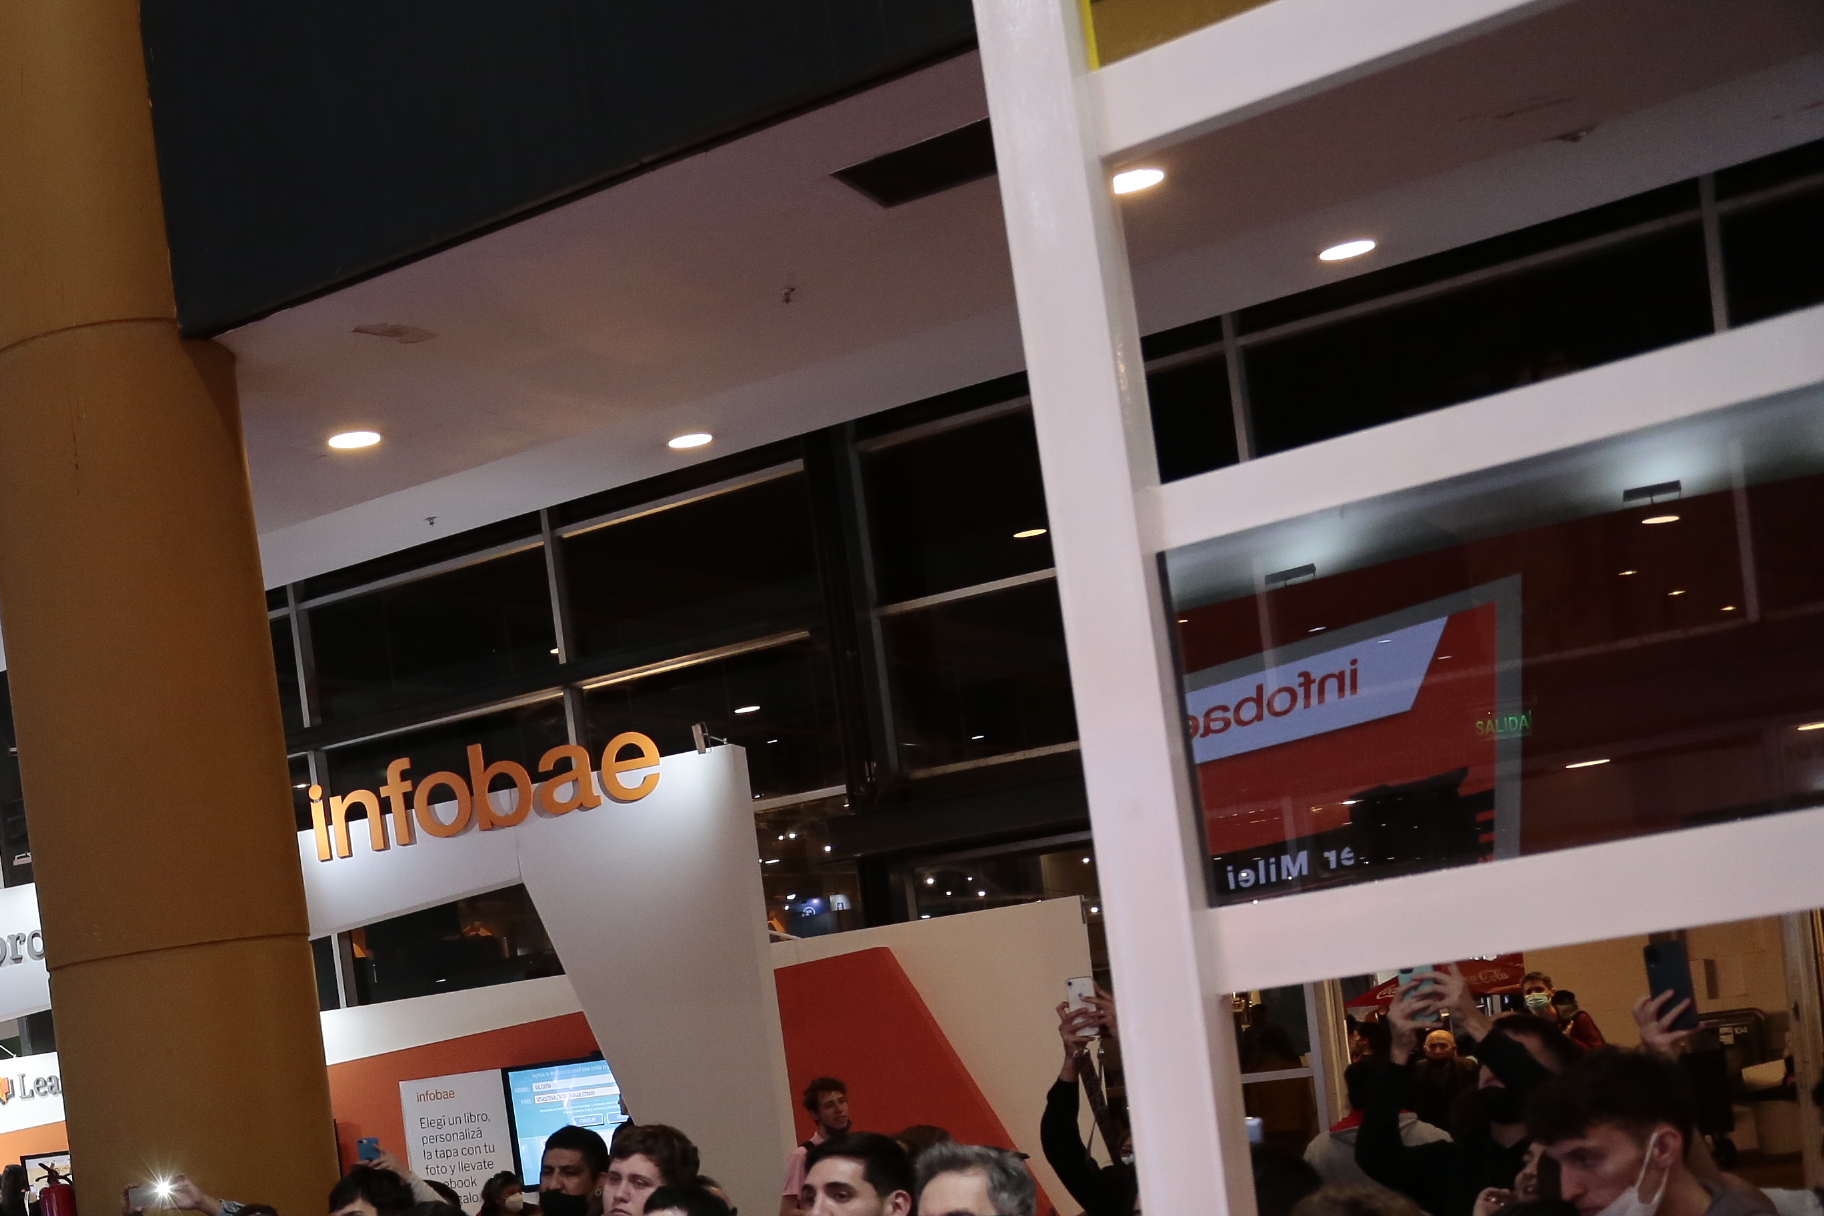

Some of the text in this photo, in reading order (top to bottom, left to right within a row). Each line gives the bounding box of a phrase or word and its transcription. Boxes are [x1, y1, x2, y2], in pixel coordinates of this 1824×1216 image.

[1475, 715, 1529, 735] SALIDA
[308, 731, 661, 862] infobae
[17, 1073, 62, 1099] Lea
[416, 1089, 456, 1103] infobae
[419, 1111, 491, 1130] Elegí un libro,
[421, 1127, 483, 1146] personalizá
[423, 1142, 496, 1161] la tapa con tu
[425, 1159, 494, 1176] foto y llevate
